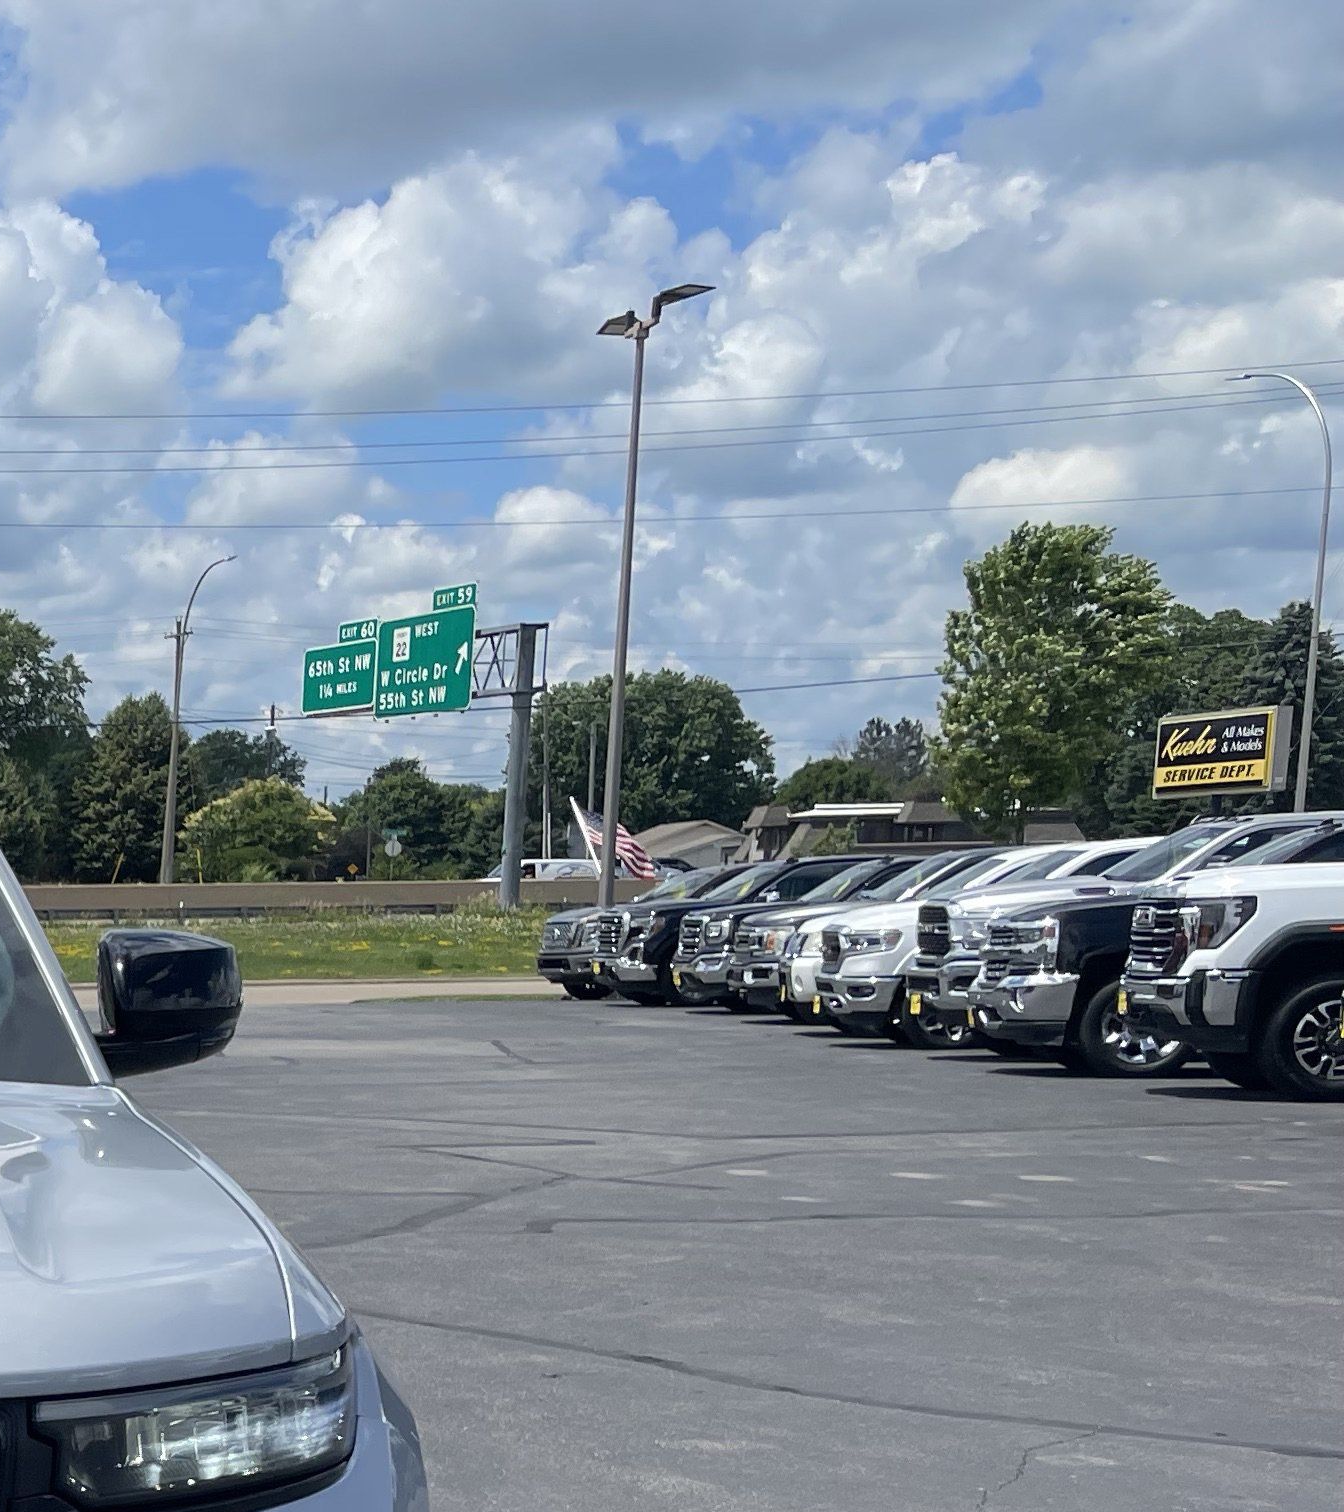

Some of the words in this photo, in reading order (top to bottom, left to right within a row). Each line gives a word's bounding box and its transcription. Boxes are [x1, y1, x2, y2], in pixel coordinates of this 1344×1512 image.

[436, 592, 455, 607] EXIT
[457, 586, 473, 605] 59
[341, 625, 358, 640] EXIT
[360, 621, 375, 638] 60
[414, 621, 440, 638] WEST
[395, 641, 407, 657] 22
[308, 660, 334, 678] 65th
[338, 656, 351, 673] St
[354, 653, 372, 671] NW
[381, 671, 391, 687] W
[394, 665, 429, 685] Circle
[433, 662, 448, 680] Dr
[336, 681, 357, 695] MILES
[379, 692, 406, 710] 55th
[411, 689, 425, 706] St
[428, 685, 447, 704] NW
[1222, 725, 1235, 739] All
[1235, 724, 1264, 738] Makes
[1161, 725, 1217, 762] Kuehn
[1220, 741, 1229, 753] &
[1230, 738, 1263, 752] Models
[1163, 766, 1216, 783] SERVICE
[1219, 763, 1256, 779] DEPT.
